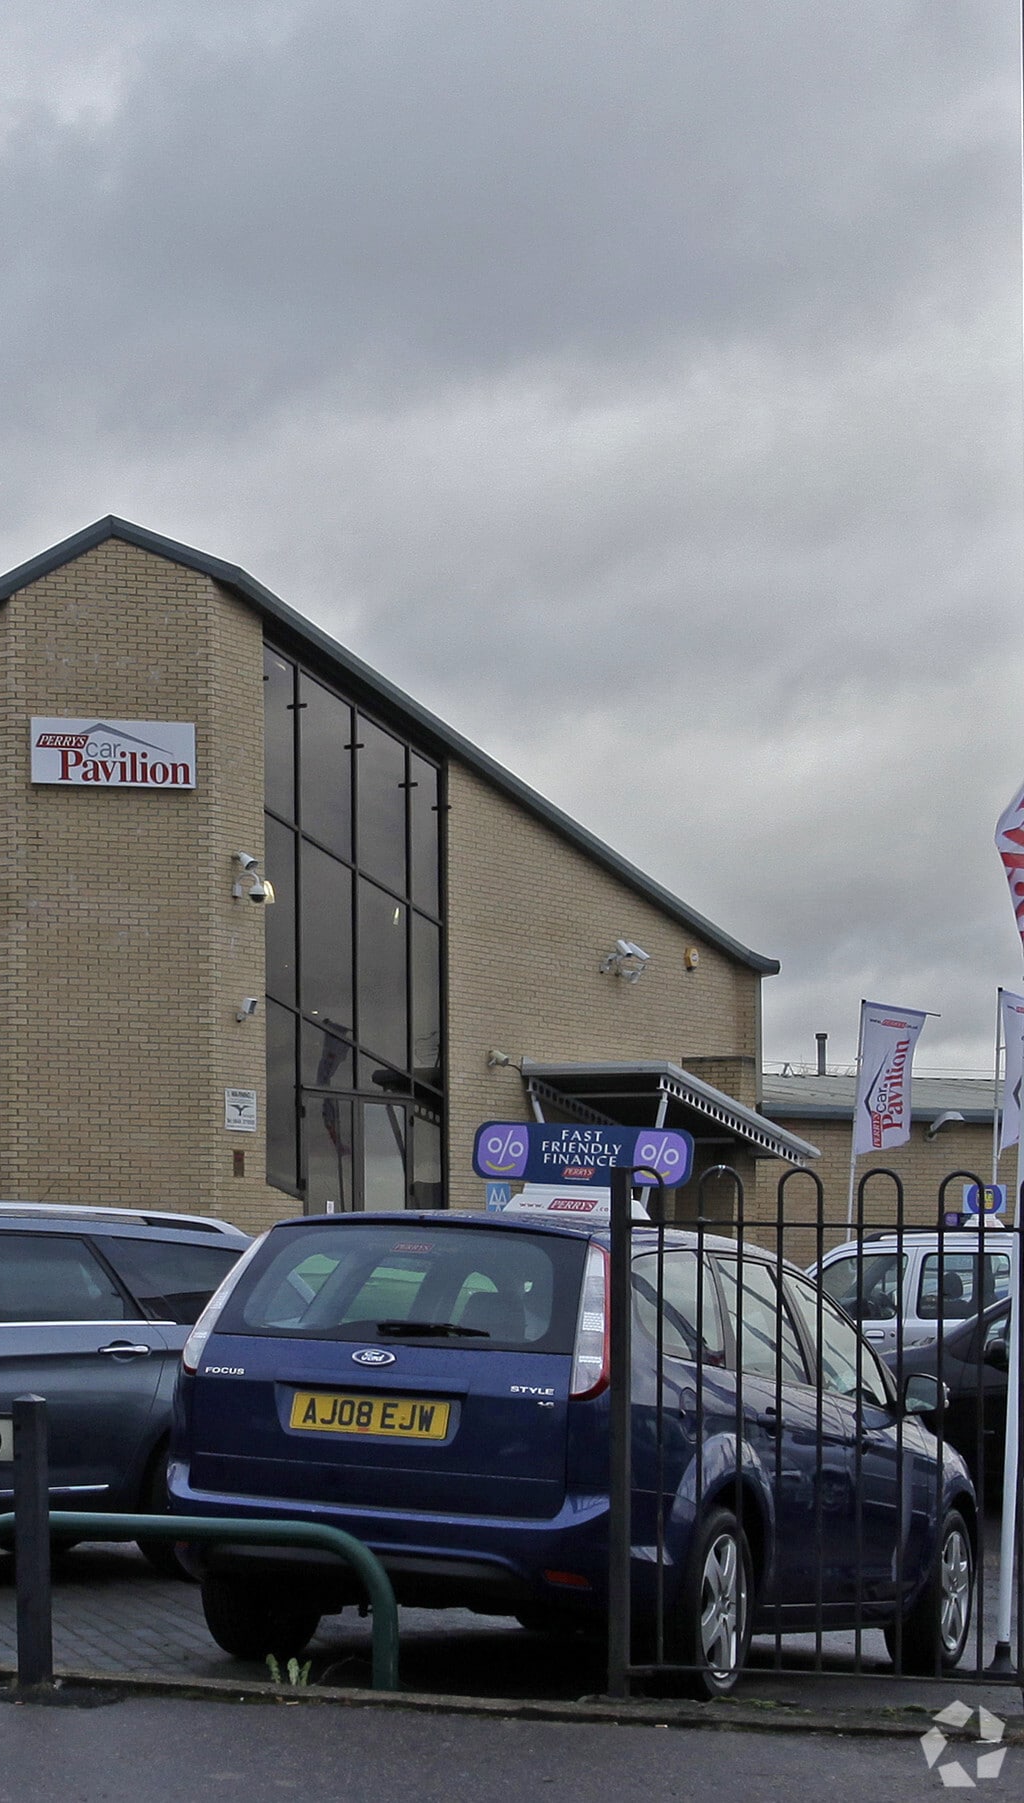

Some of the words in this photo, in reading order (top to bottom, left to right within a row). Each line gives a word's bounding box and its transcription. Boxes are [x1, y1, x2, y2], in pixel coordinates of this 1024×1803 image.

[38, 735, 86, 747] PERRYS
[86, 741, 121, 758] car
[57, 749, 192, 785] Pavilion
[882, 1039, 911, 1130] Pavilion
[876, 1087, 887, 1113] car
[561, 1129, 603, 1142] FAST
[541, 1140, 622, 1155] FRIENDLY
[543, 1152, 617, 1167] FINANCE
[205, 1366, 245, 1375] FOCUS
[510, 1385, 555, 1396] STYLE
[302, 1398, 374, 1427] AJ08
[379, 1402, 435, 1432] EJW
